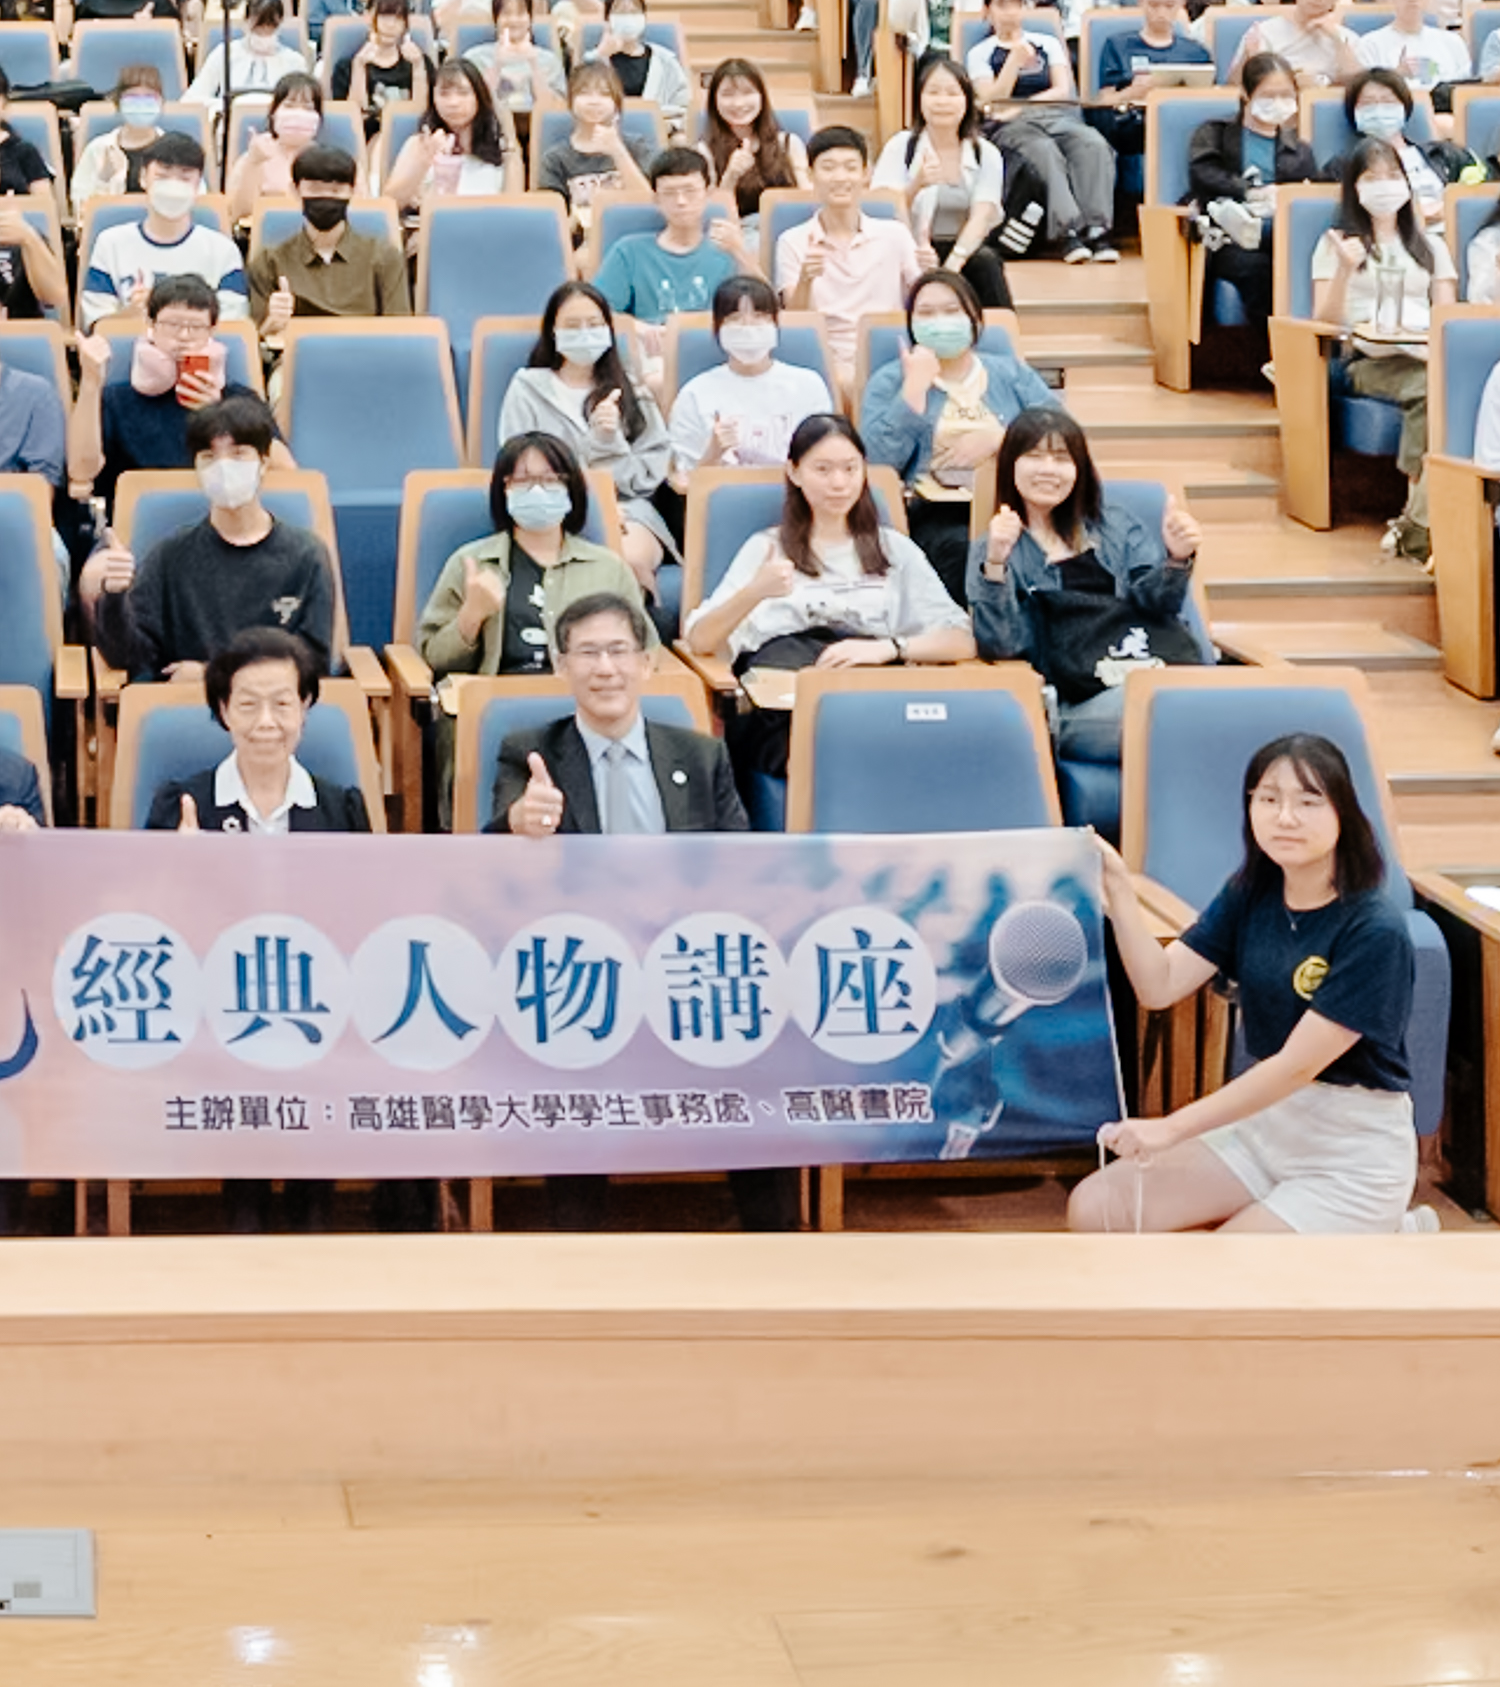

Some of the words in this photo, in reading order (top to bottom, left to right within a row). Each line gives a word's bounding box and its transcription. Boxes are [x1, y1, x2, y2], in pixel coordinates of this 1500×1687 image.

[69, 927, 922, 1048] 經典人物講座
